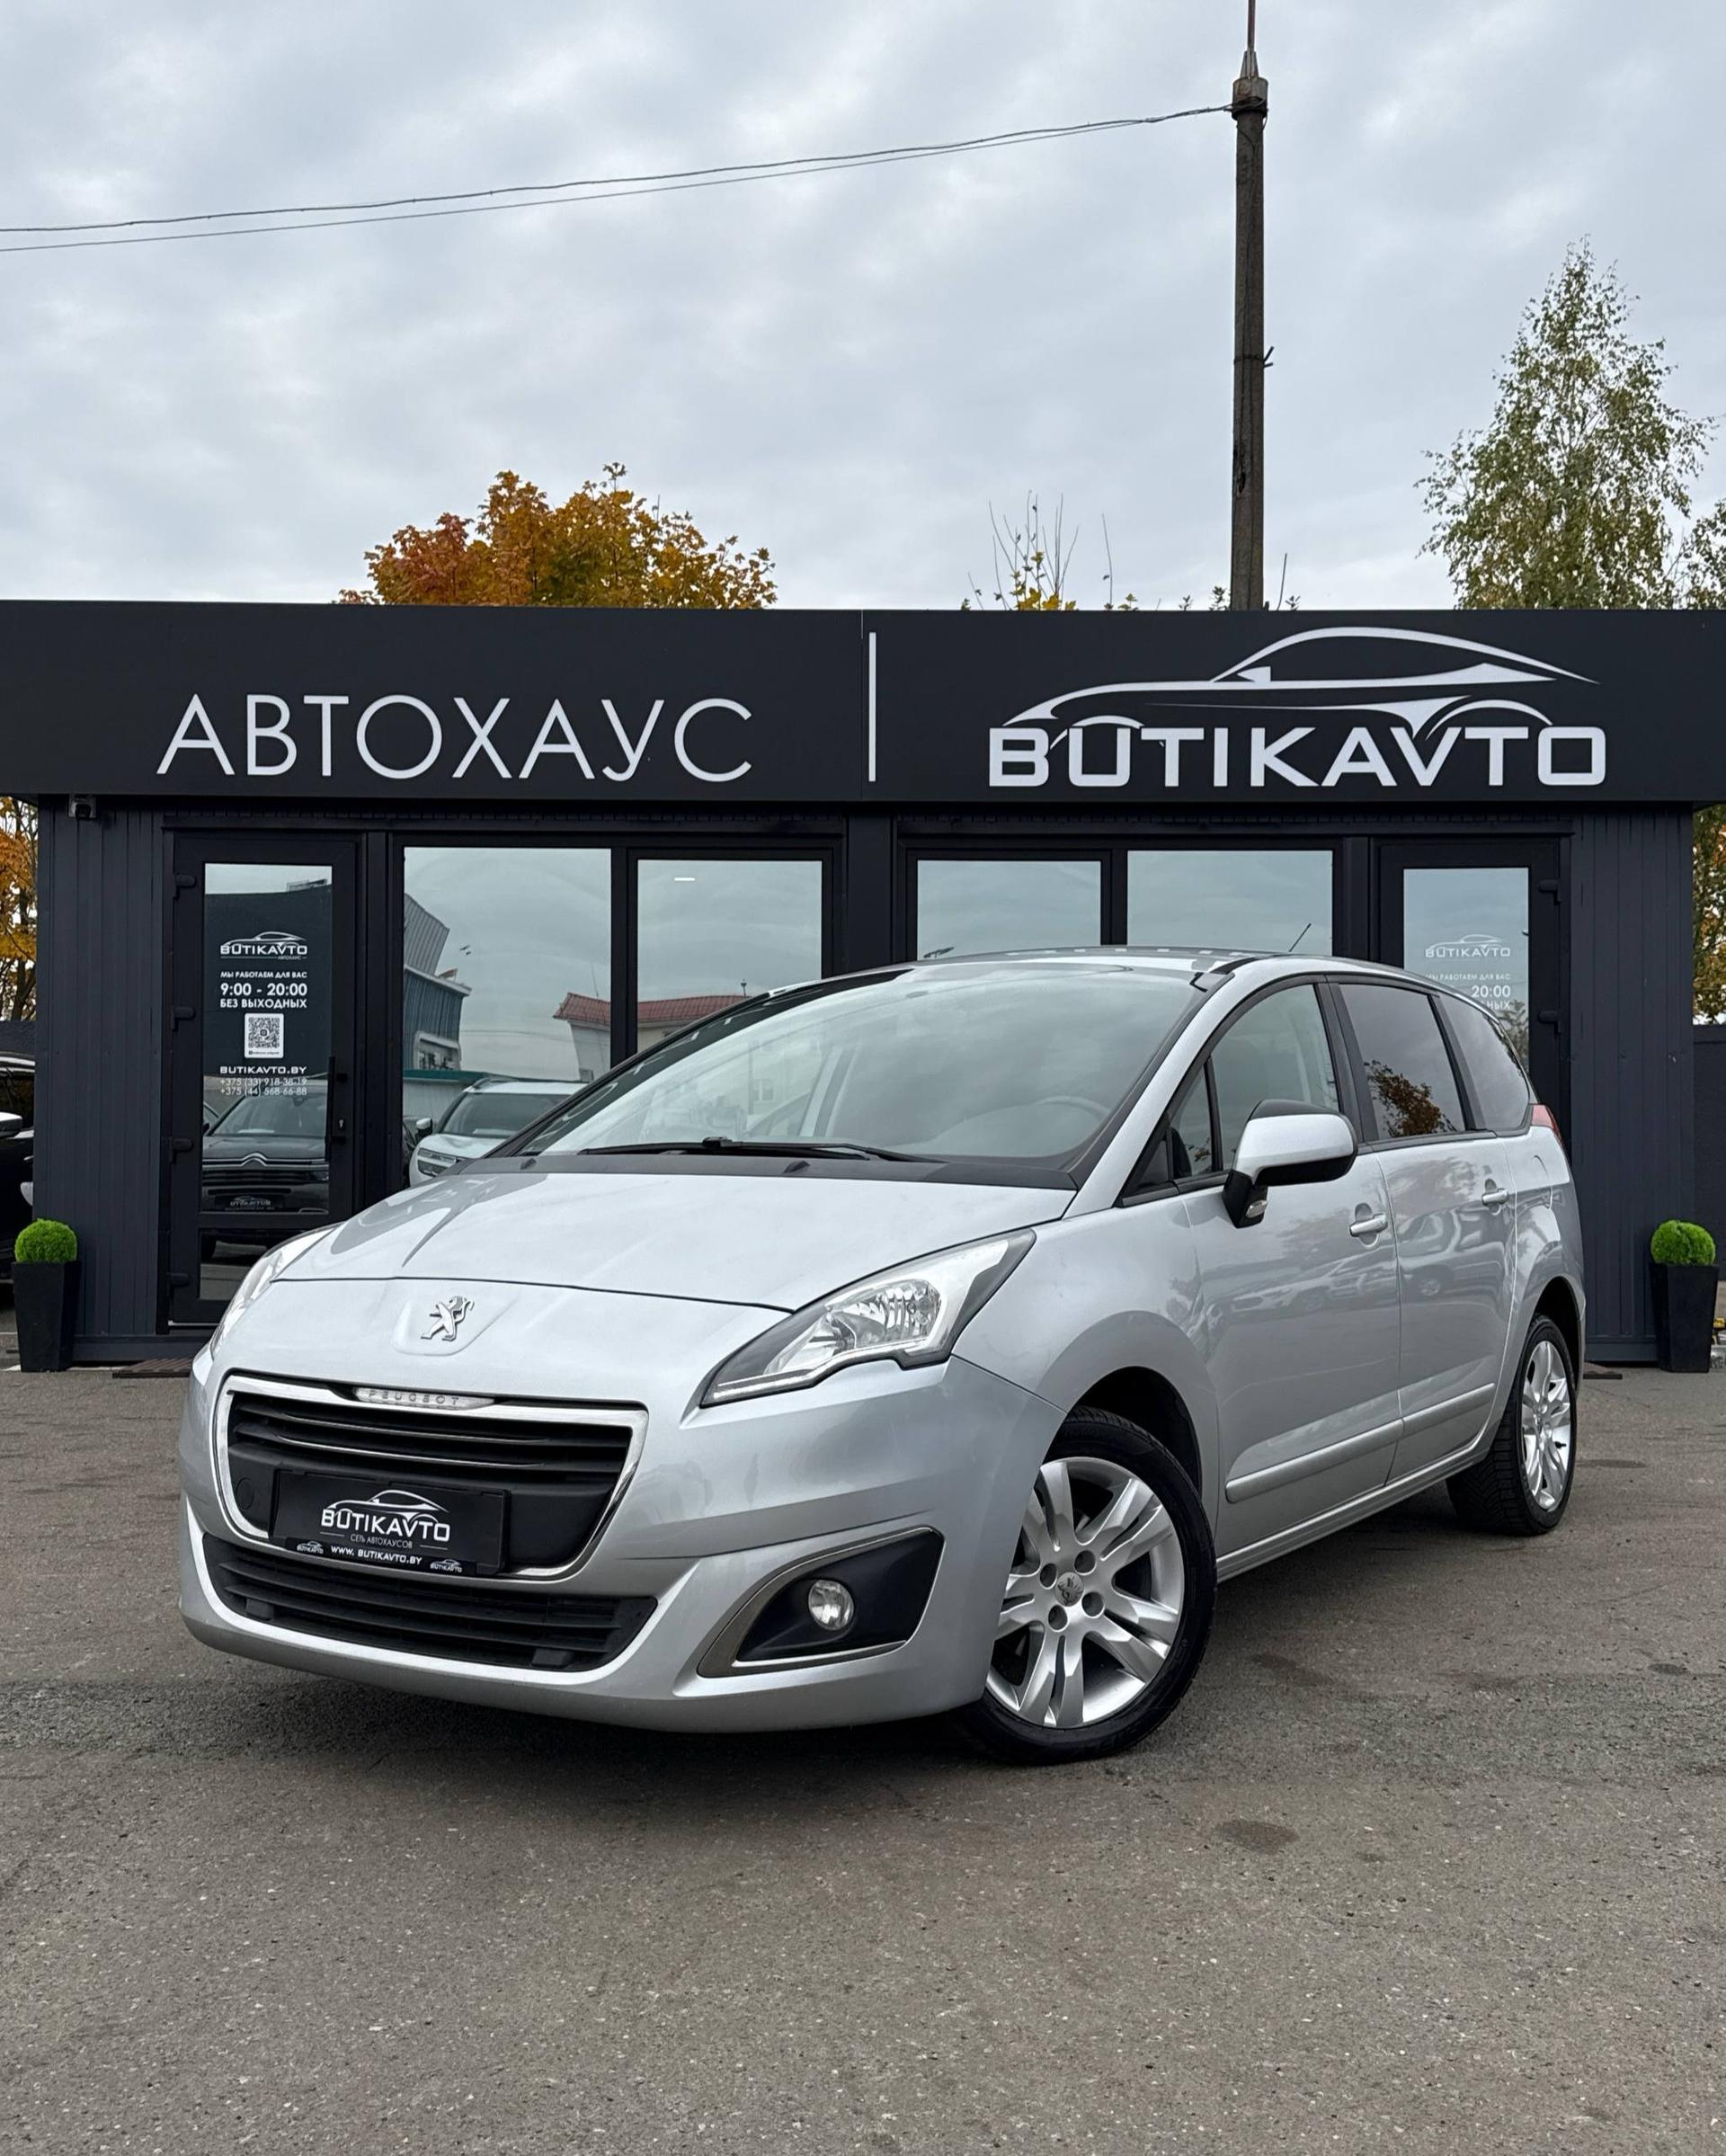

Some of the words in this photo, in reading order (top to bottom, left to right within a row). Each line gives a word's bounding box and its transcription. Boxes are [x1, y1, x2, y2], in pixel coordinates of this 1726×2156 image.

[156, 693, 753, 782] АВТОХАУС
[989, 725, 1607, 788] BUTIKAVTO
[220, 944, 307, 955] BUTIKAVTO
[1425, 947, 1510, 958] BUTIKAVTO
[275, 971, 290, 979] ДЛЯ
[220, 983, 252, 996] 9:00
[267, 983, 307, 996] 20:00
[1472, 985, 1511, 998] 20:00
[220, 999, 239, 1008] БЕЗ
[241, 999, 307, 1009] ВЫХОДНЫХ
[220, 1078, 242, 1086] +375
[245, 1078, 261, 1087] (33)
[220, 1087, 242, 1095] +375
[245, 1087, 261, 1096] (44)
[369, 1390, 459, 1405] PEUGEOT
[321, 1509, 451, 1542] BUTIKAVTO
[350, 1534, 366, 1543] СЕТЬ
[367, 1537, 414, 1549] АВТОХАУСОВ
[330, 1546, 355, 1556] WWW.
[358, 1549, 423, 1565] BUTIKAVTO.BY
